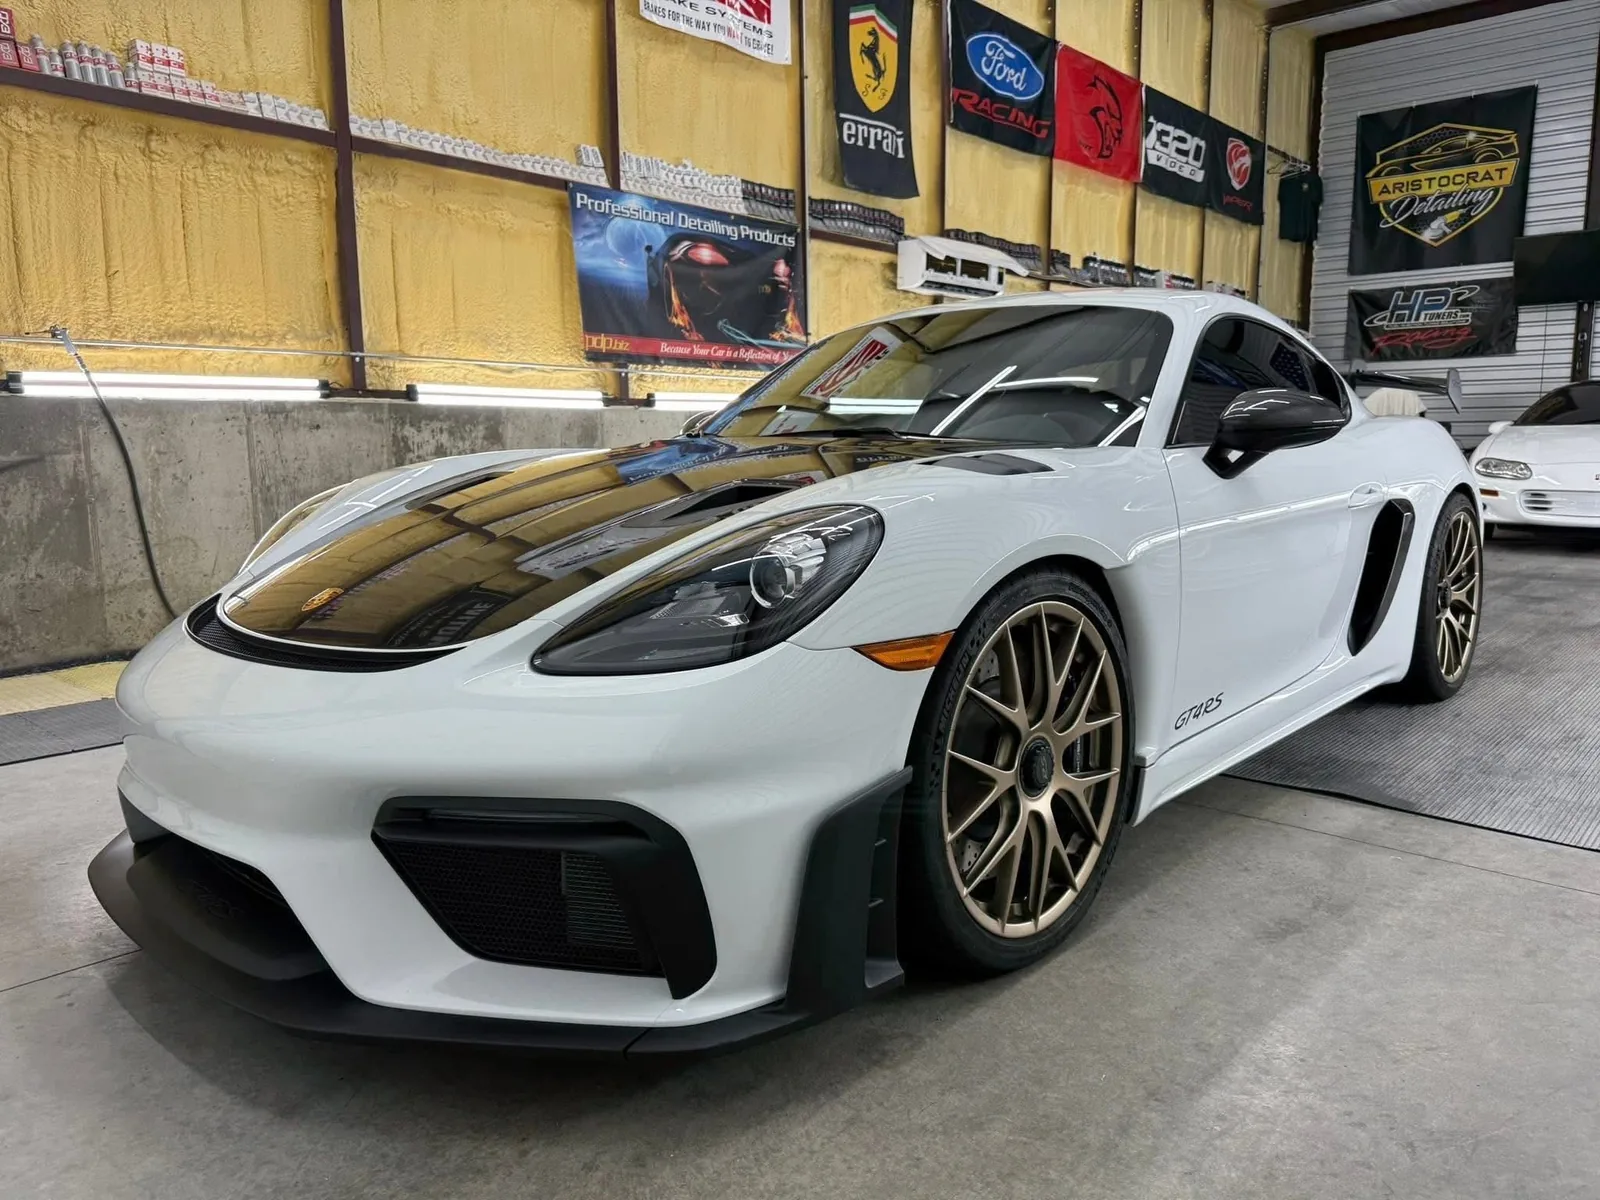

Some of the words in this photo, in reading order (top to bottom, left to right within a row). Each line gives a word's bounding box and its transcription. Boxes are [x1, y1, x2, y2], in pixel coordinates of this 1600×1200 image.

[668, 9, 680, 22] FOR
[681, 14, 693, 28] THE
[695, 19, 711, 32] WAY
[712, 22, 726, 36] YOU
[981, 40, 1027, 92] Ford
[952, 88, 1050, 139] RACING
[1155, 153, 1197, 178] VIDEO
[1378, 167, 1508, 197] ARISTOCRAT
[576, 192, 675, 227] Professional
[677, 212, 739, 241] Detailing
[740, 225, 796, 248] Products
[1380, 184, 1495, 228] Detailing
[1386, 287, 1452, 324] HP
[1423, 310, 1460, 321] TUNERS
[660, 342, 692, 354] Because
[693, 344, 709, 356] Your
[710, 347, 725, 358] Car
[727, 349, 733, 358] is
[733, 351, 739, 359] a
[739, 347, 772, 362] Reflection
[772, 351, 781, 364] of
[1174, 691, 1224, 731] GT4RS
